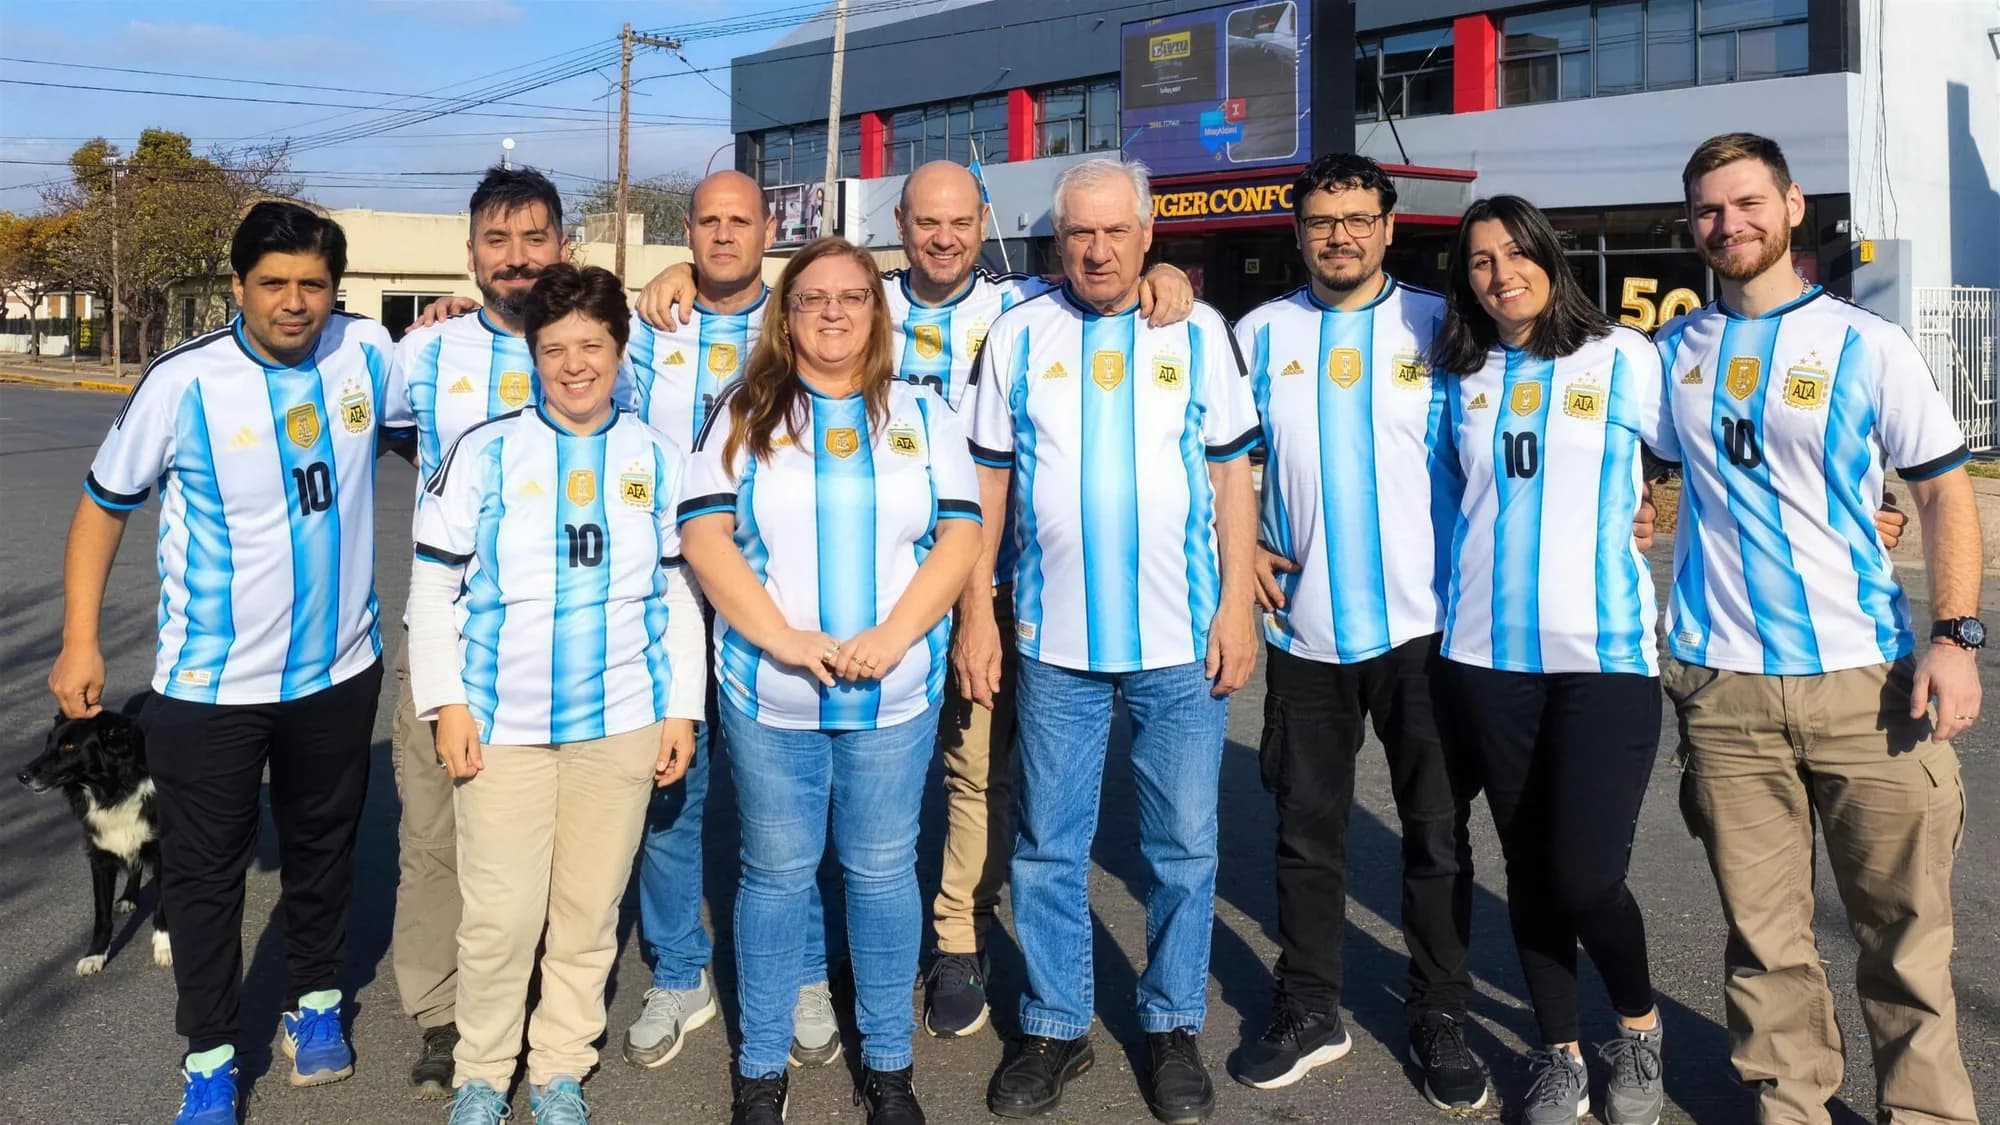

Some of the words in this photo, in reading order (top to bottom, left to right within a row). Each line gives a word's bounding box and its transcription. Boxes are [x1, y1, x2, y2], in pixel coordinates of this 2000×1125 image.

[1619, 277, 1702, 332] 50
[1502, 431, 1538, 479] 10
[1721, 416, 1762, 469] 10
[292, 461, 333, 516] 10
[564, 523, 604, 568] 10
